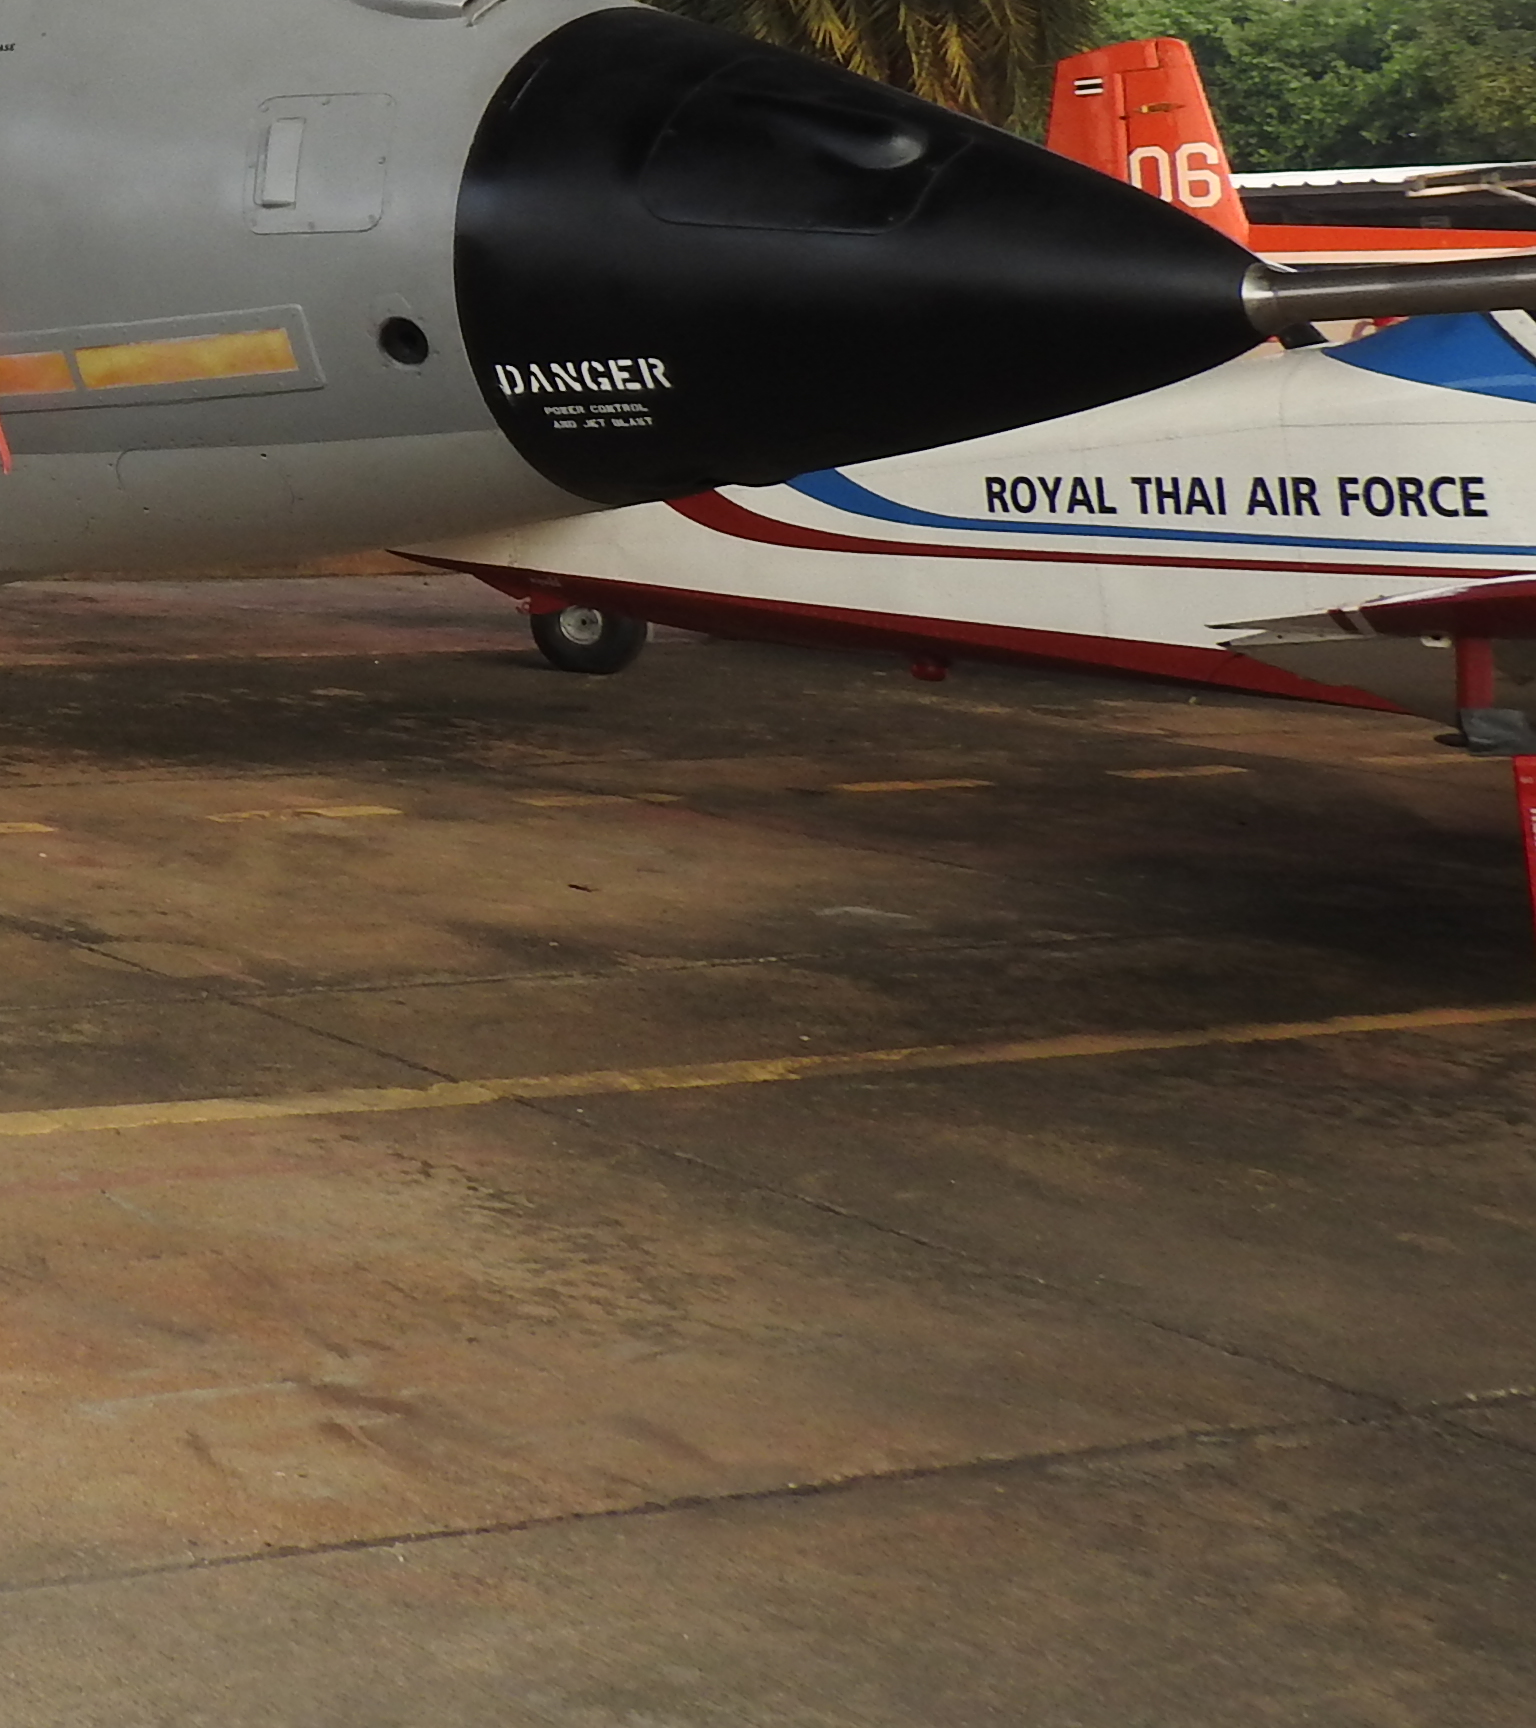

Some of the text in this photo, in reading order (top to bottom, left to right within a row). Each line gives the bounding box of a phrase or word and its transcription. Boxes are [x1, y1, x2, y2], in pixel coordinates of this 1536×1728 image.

[1129, 142, 1222, 208] 06
[494, 357, 673, 396] DANGER
[589, 403, 650, 414] CONTROL
[985, 475, 1489, 518] ROYAL THAI AIR FORCE
